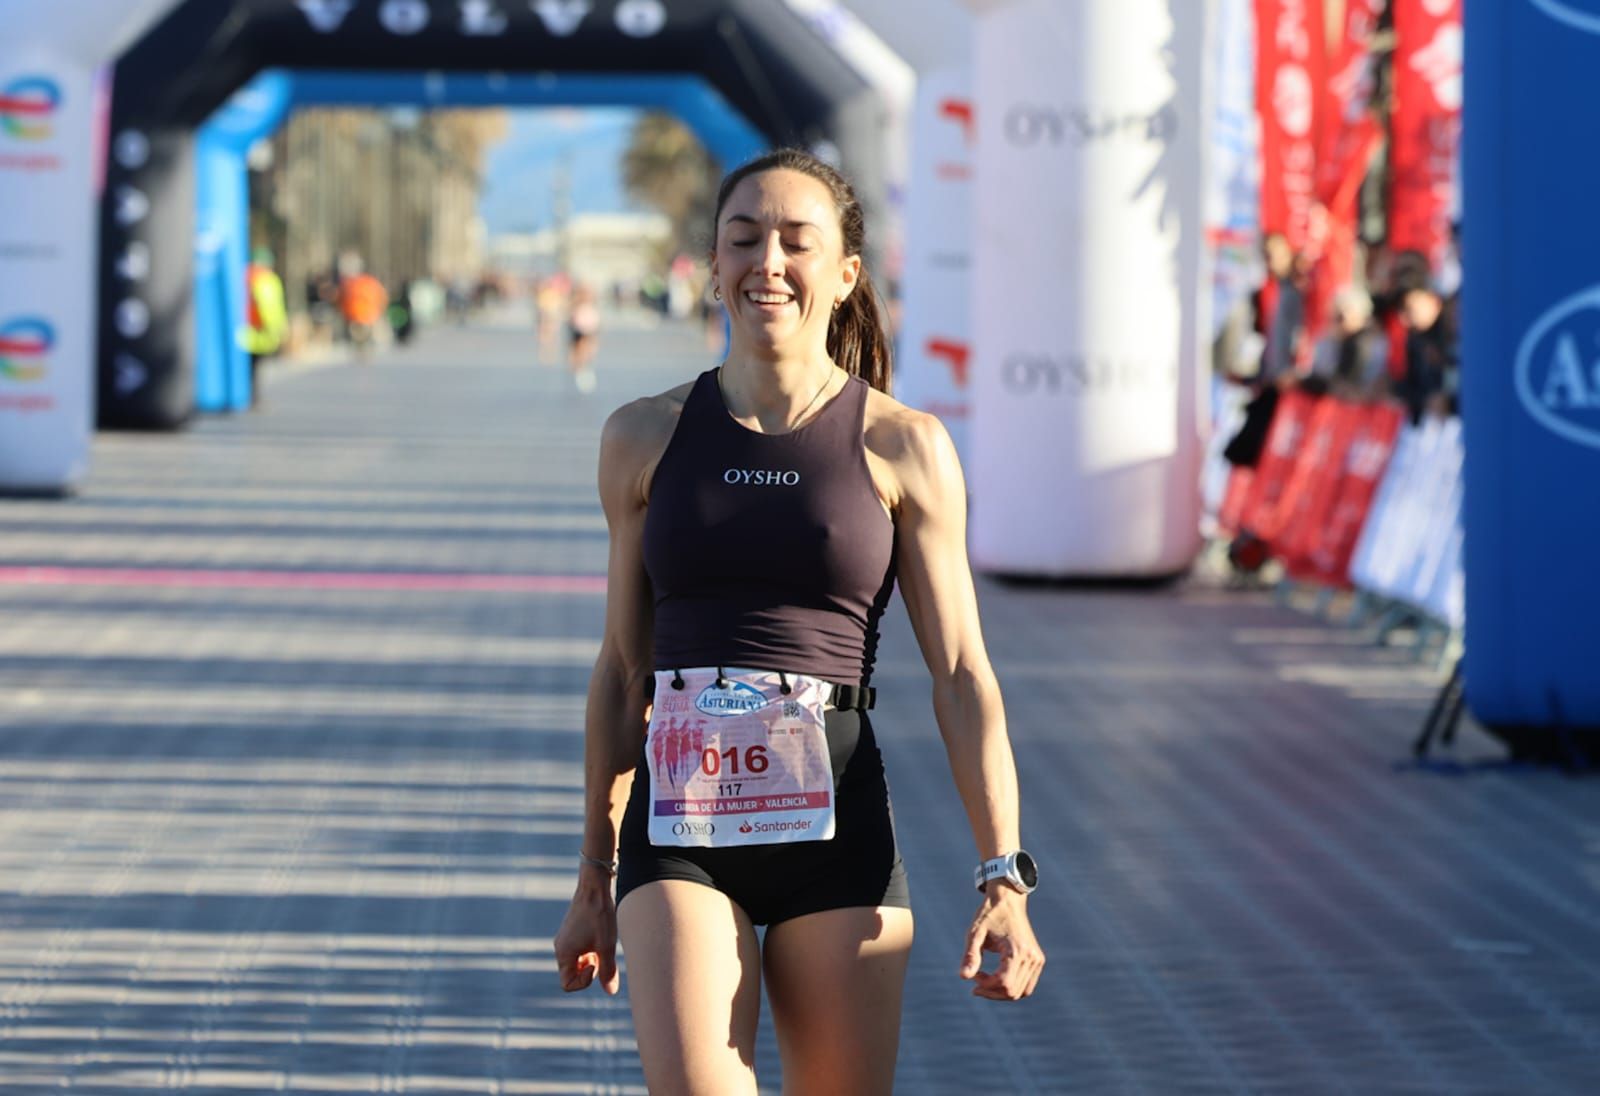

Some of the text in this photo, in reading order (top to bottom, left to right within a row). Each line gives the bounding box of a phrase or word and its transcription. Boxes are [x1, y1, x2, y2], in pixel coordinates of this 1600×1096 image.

[297, 0, 667, 37] VOLVO
[1000, 352, 1177, 398] OYSH
[724, 468, 800, 486] OYSHO
[702, 745, 769, 776] 016
[718, 783, 742, 797] 117
[701, 802, 711, 812] DE
[713, 802, 725, 811] LA
[727, 800, 757, 811] MUJER
[765, 797, 808, 808] VALENCIA
[672, 822, 715, 836] OYSHO
[754, 819, 812, 832] Santander
